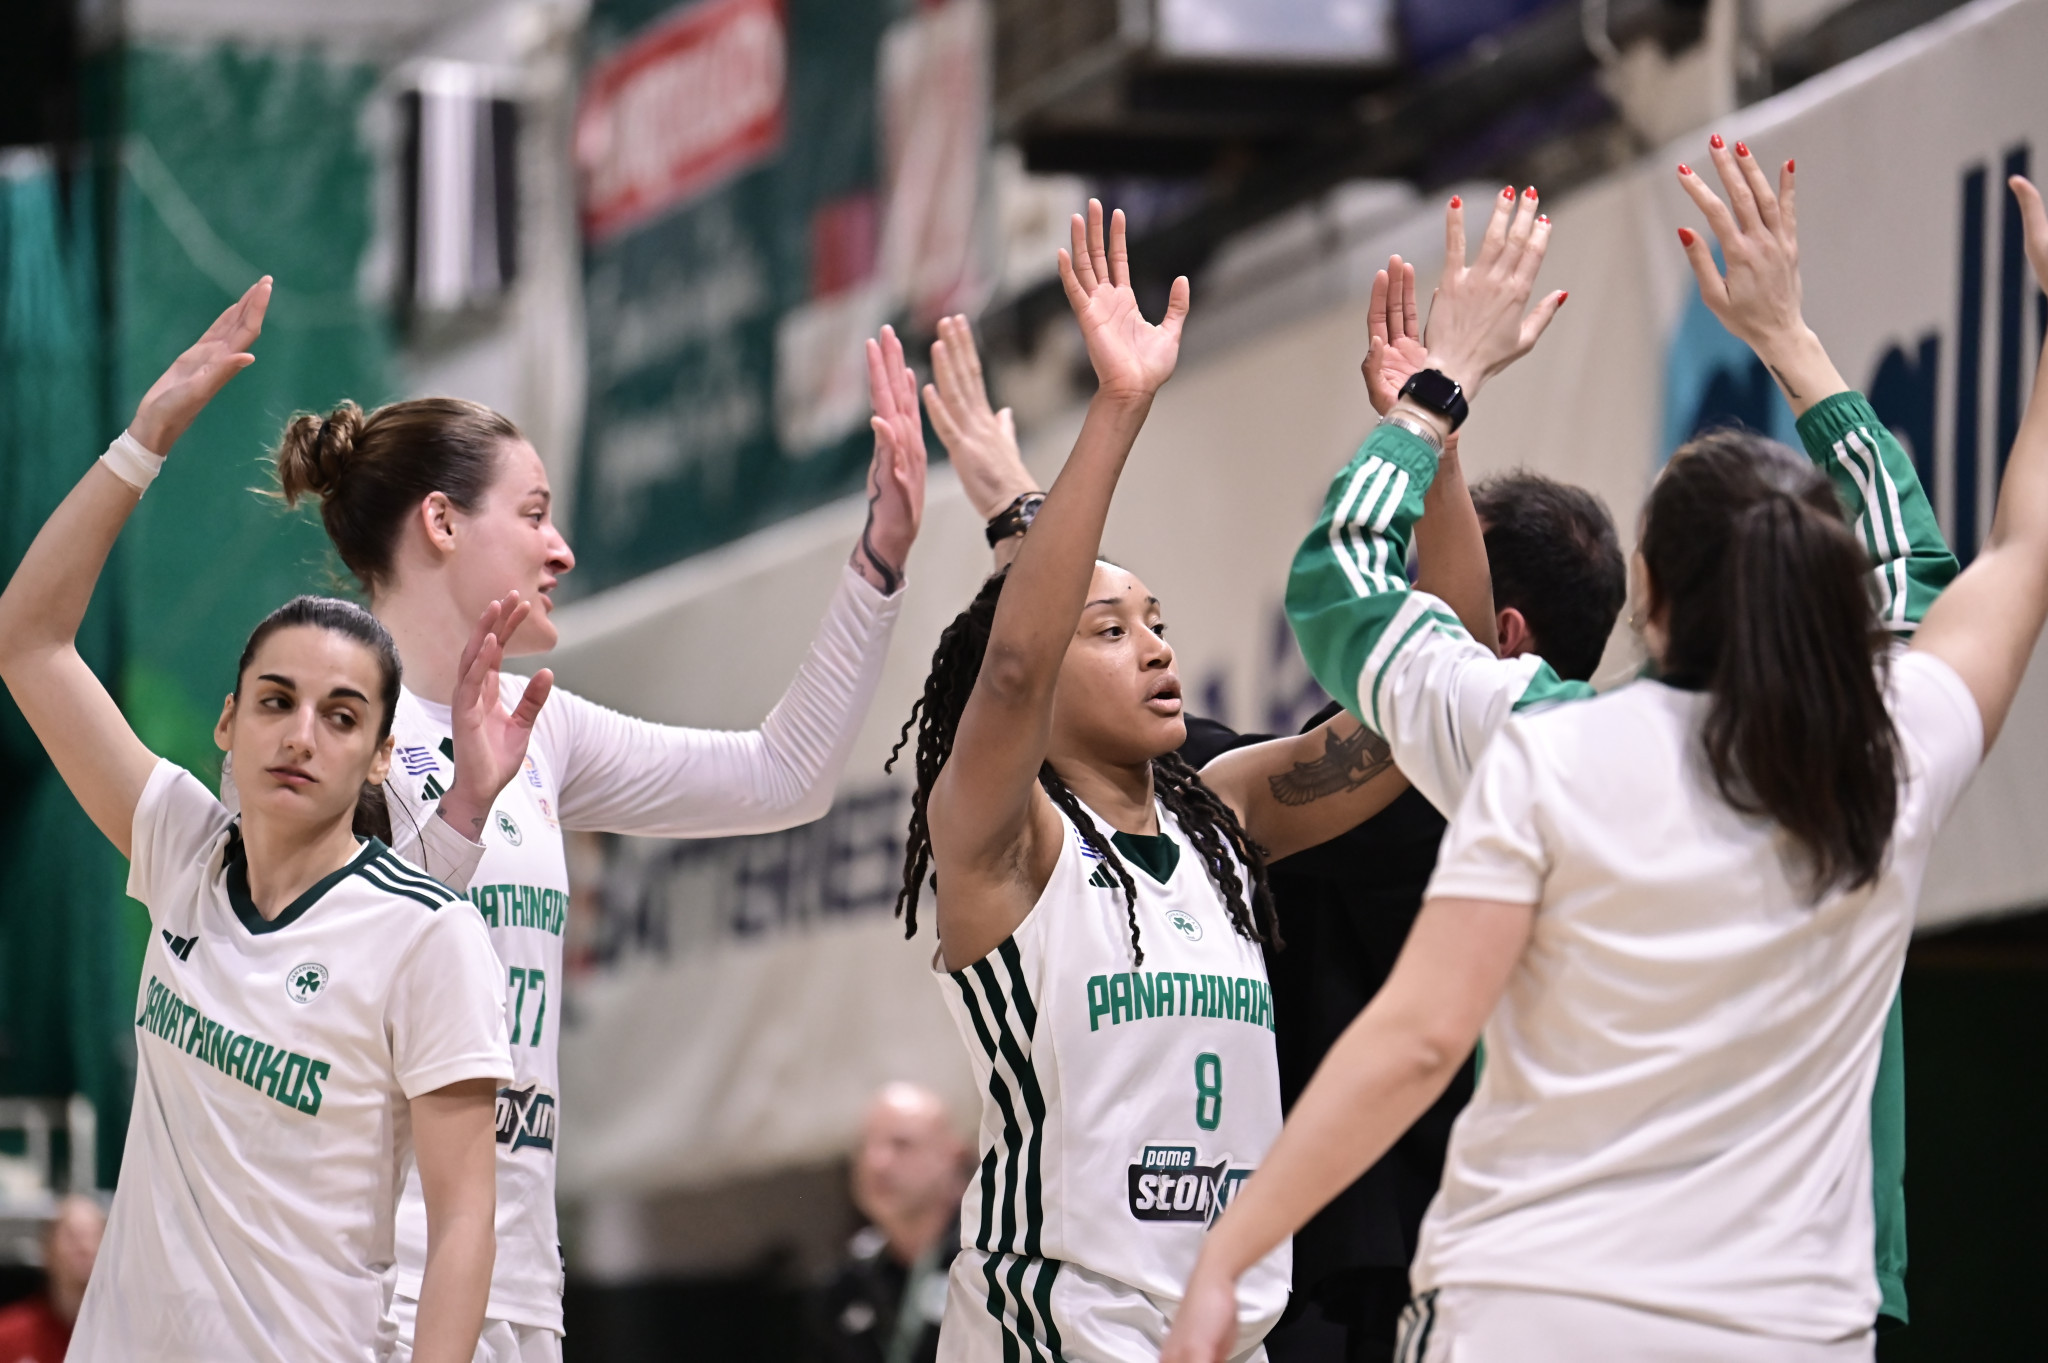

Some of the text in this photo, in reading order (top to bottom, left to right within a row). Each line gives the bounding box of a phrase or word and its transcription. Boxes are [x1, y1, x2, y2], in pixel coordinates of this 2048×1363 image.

[509, 966, 546, 1047] 77
[1195, 1052, 1222, 1131] 8
[1145, 1150, 1191, 1168] pame
